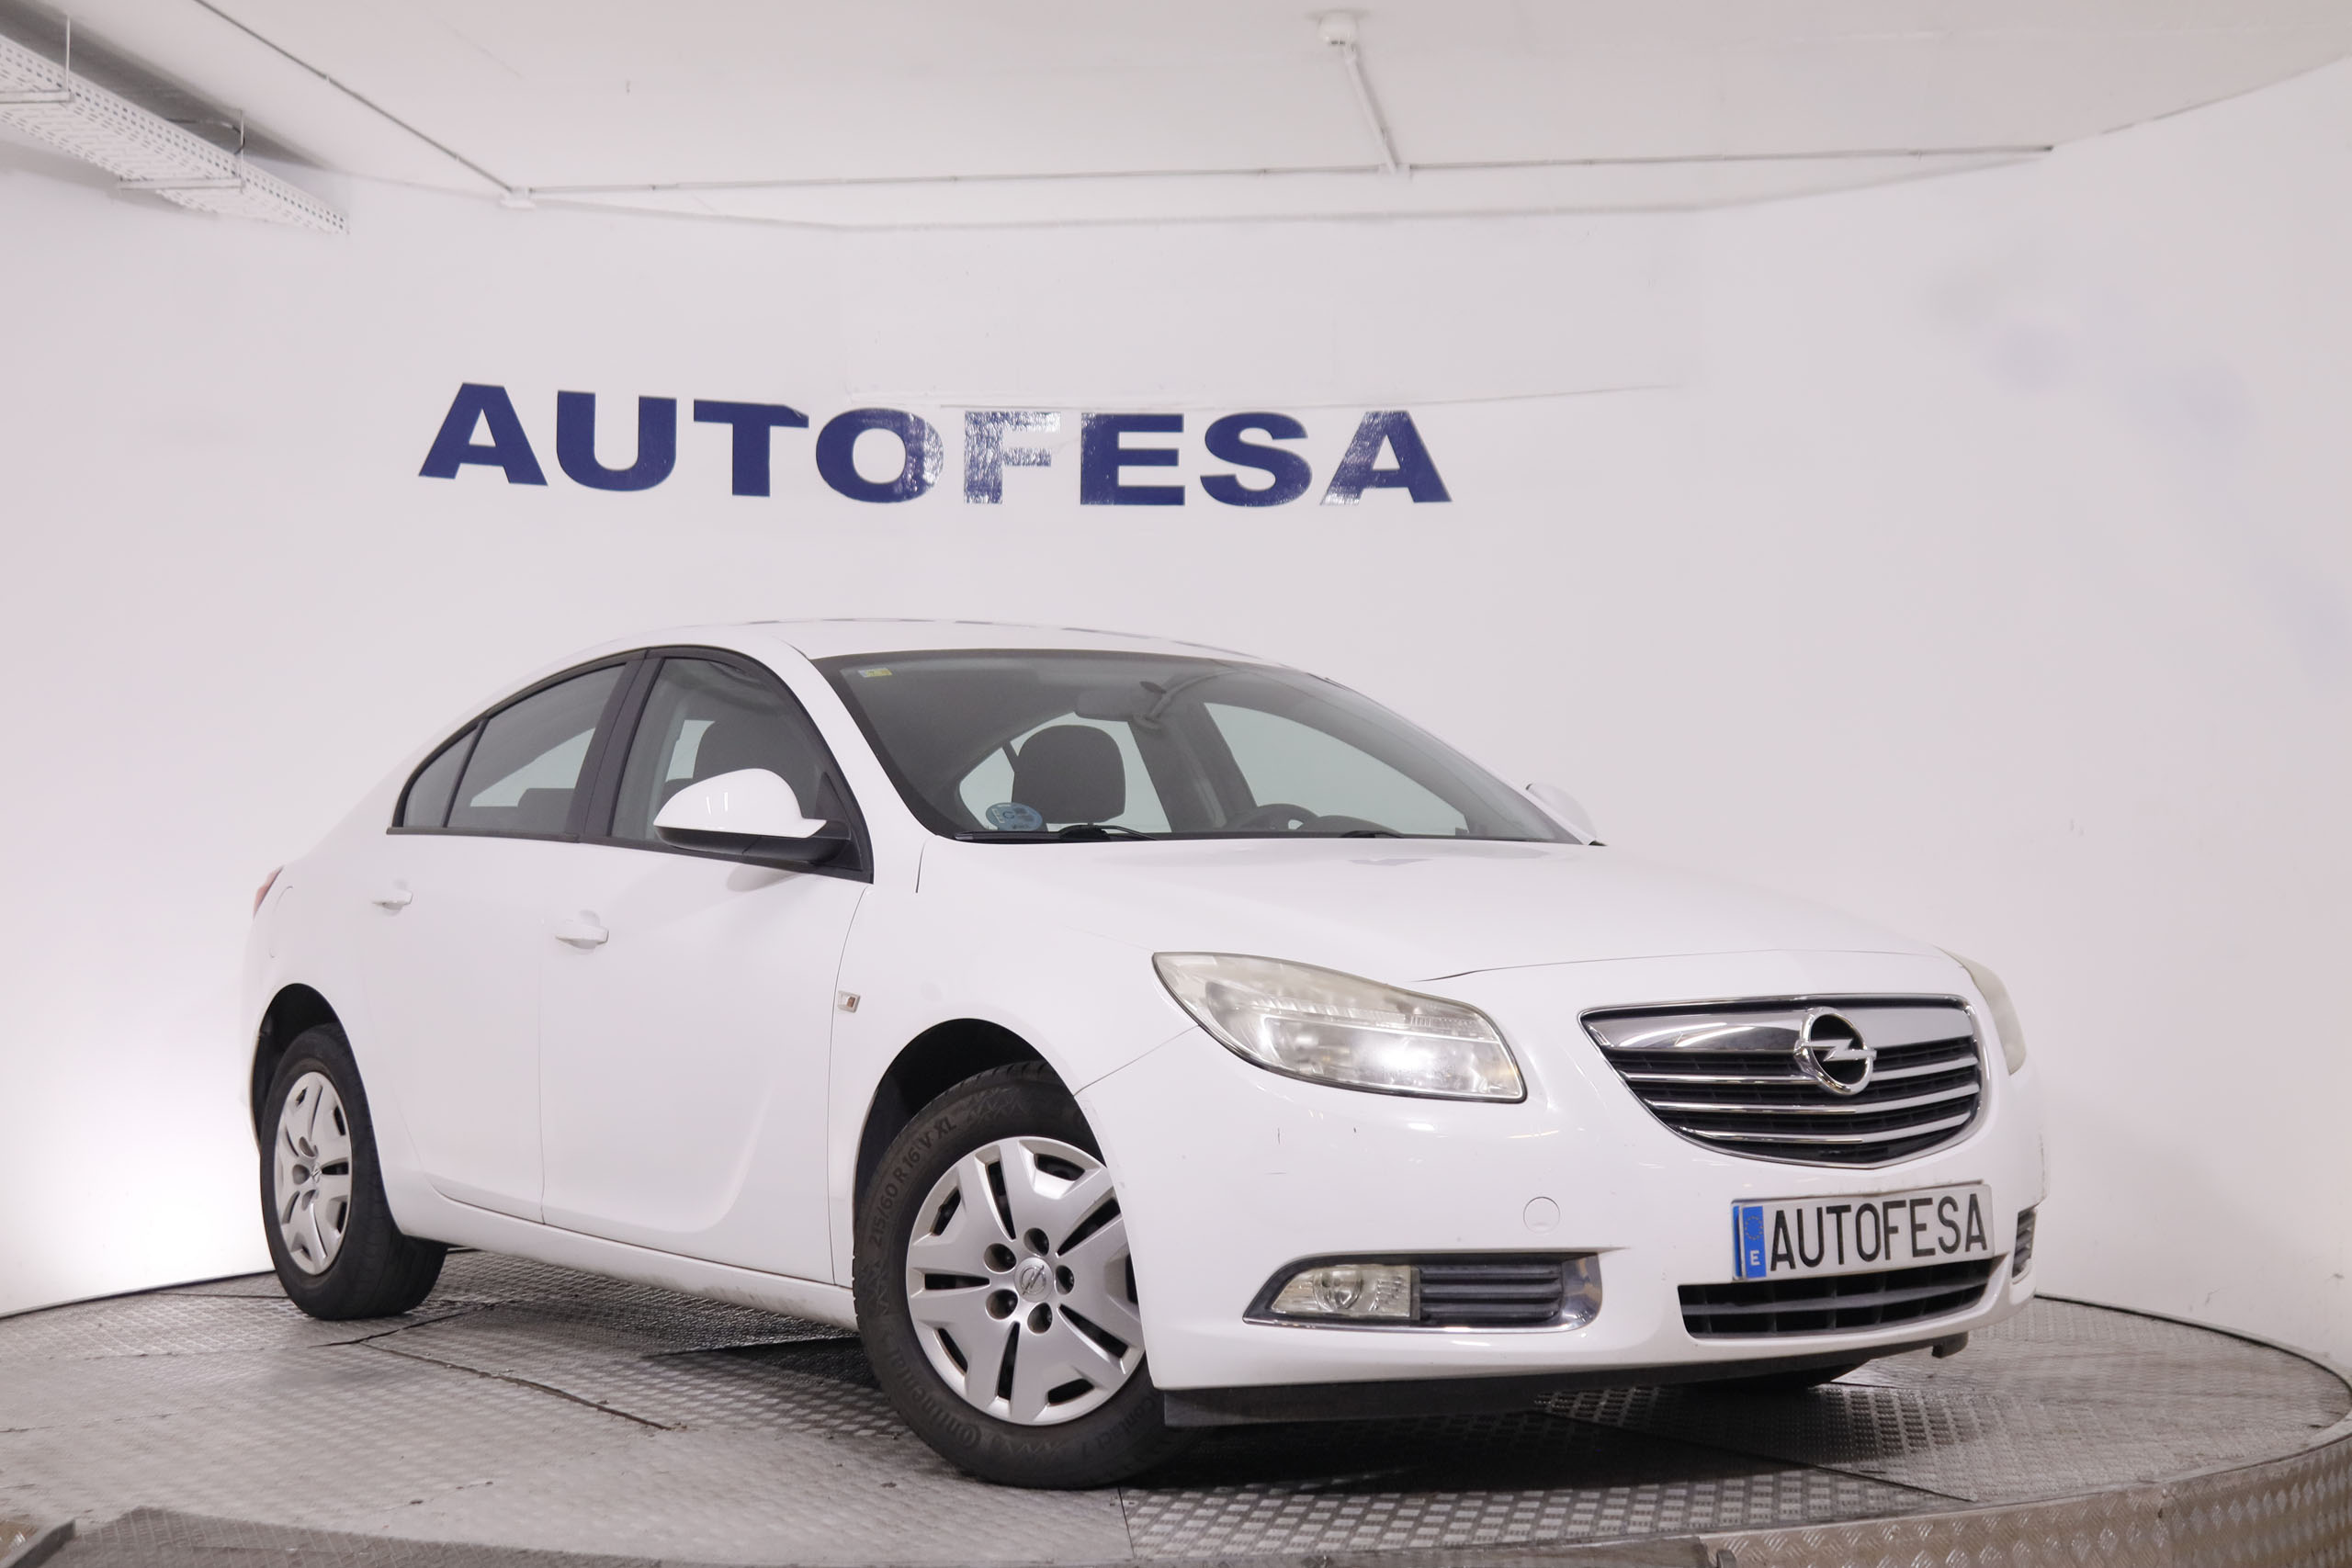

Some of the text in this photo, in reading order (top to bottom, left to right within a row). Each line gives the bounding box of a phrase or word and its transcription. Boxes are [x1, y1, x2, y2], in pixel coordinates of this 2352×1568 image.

[418, 381, 1453, 507] AUTOFESA
[869, 1115, 957, 1247] 215/60 R 16 V XL
[1770, 1192, 1988, 1272] AUTOFESA
[1749, 1249, 1760, 1266] E
